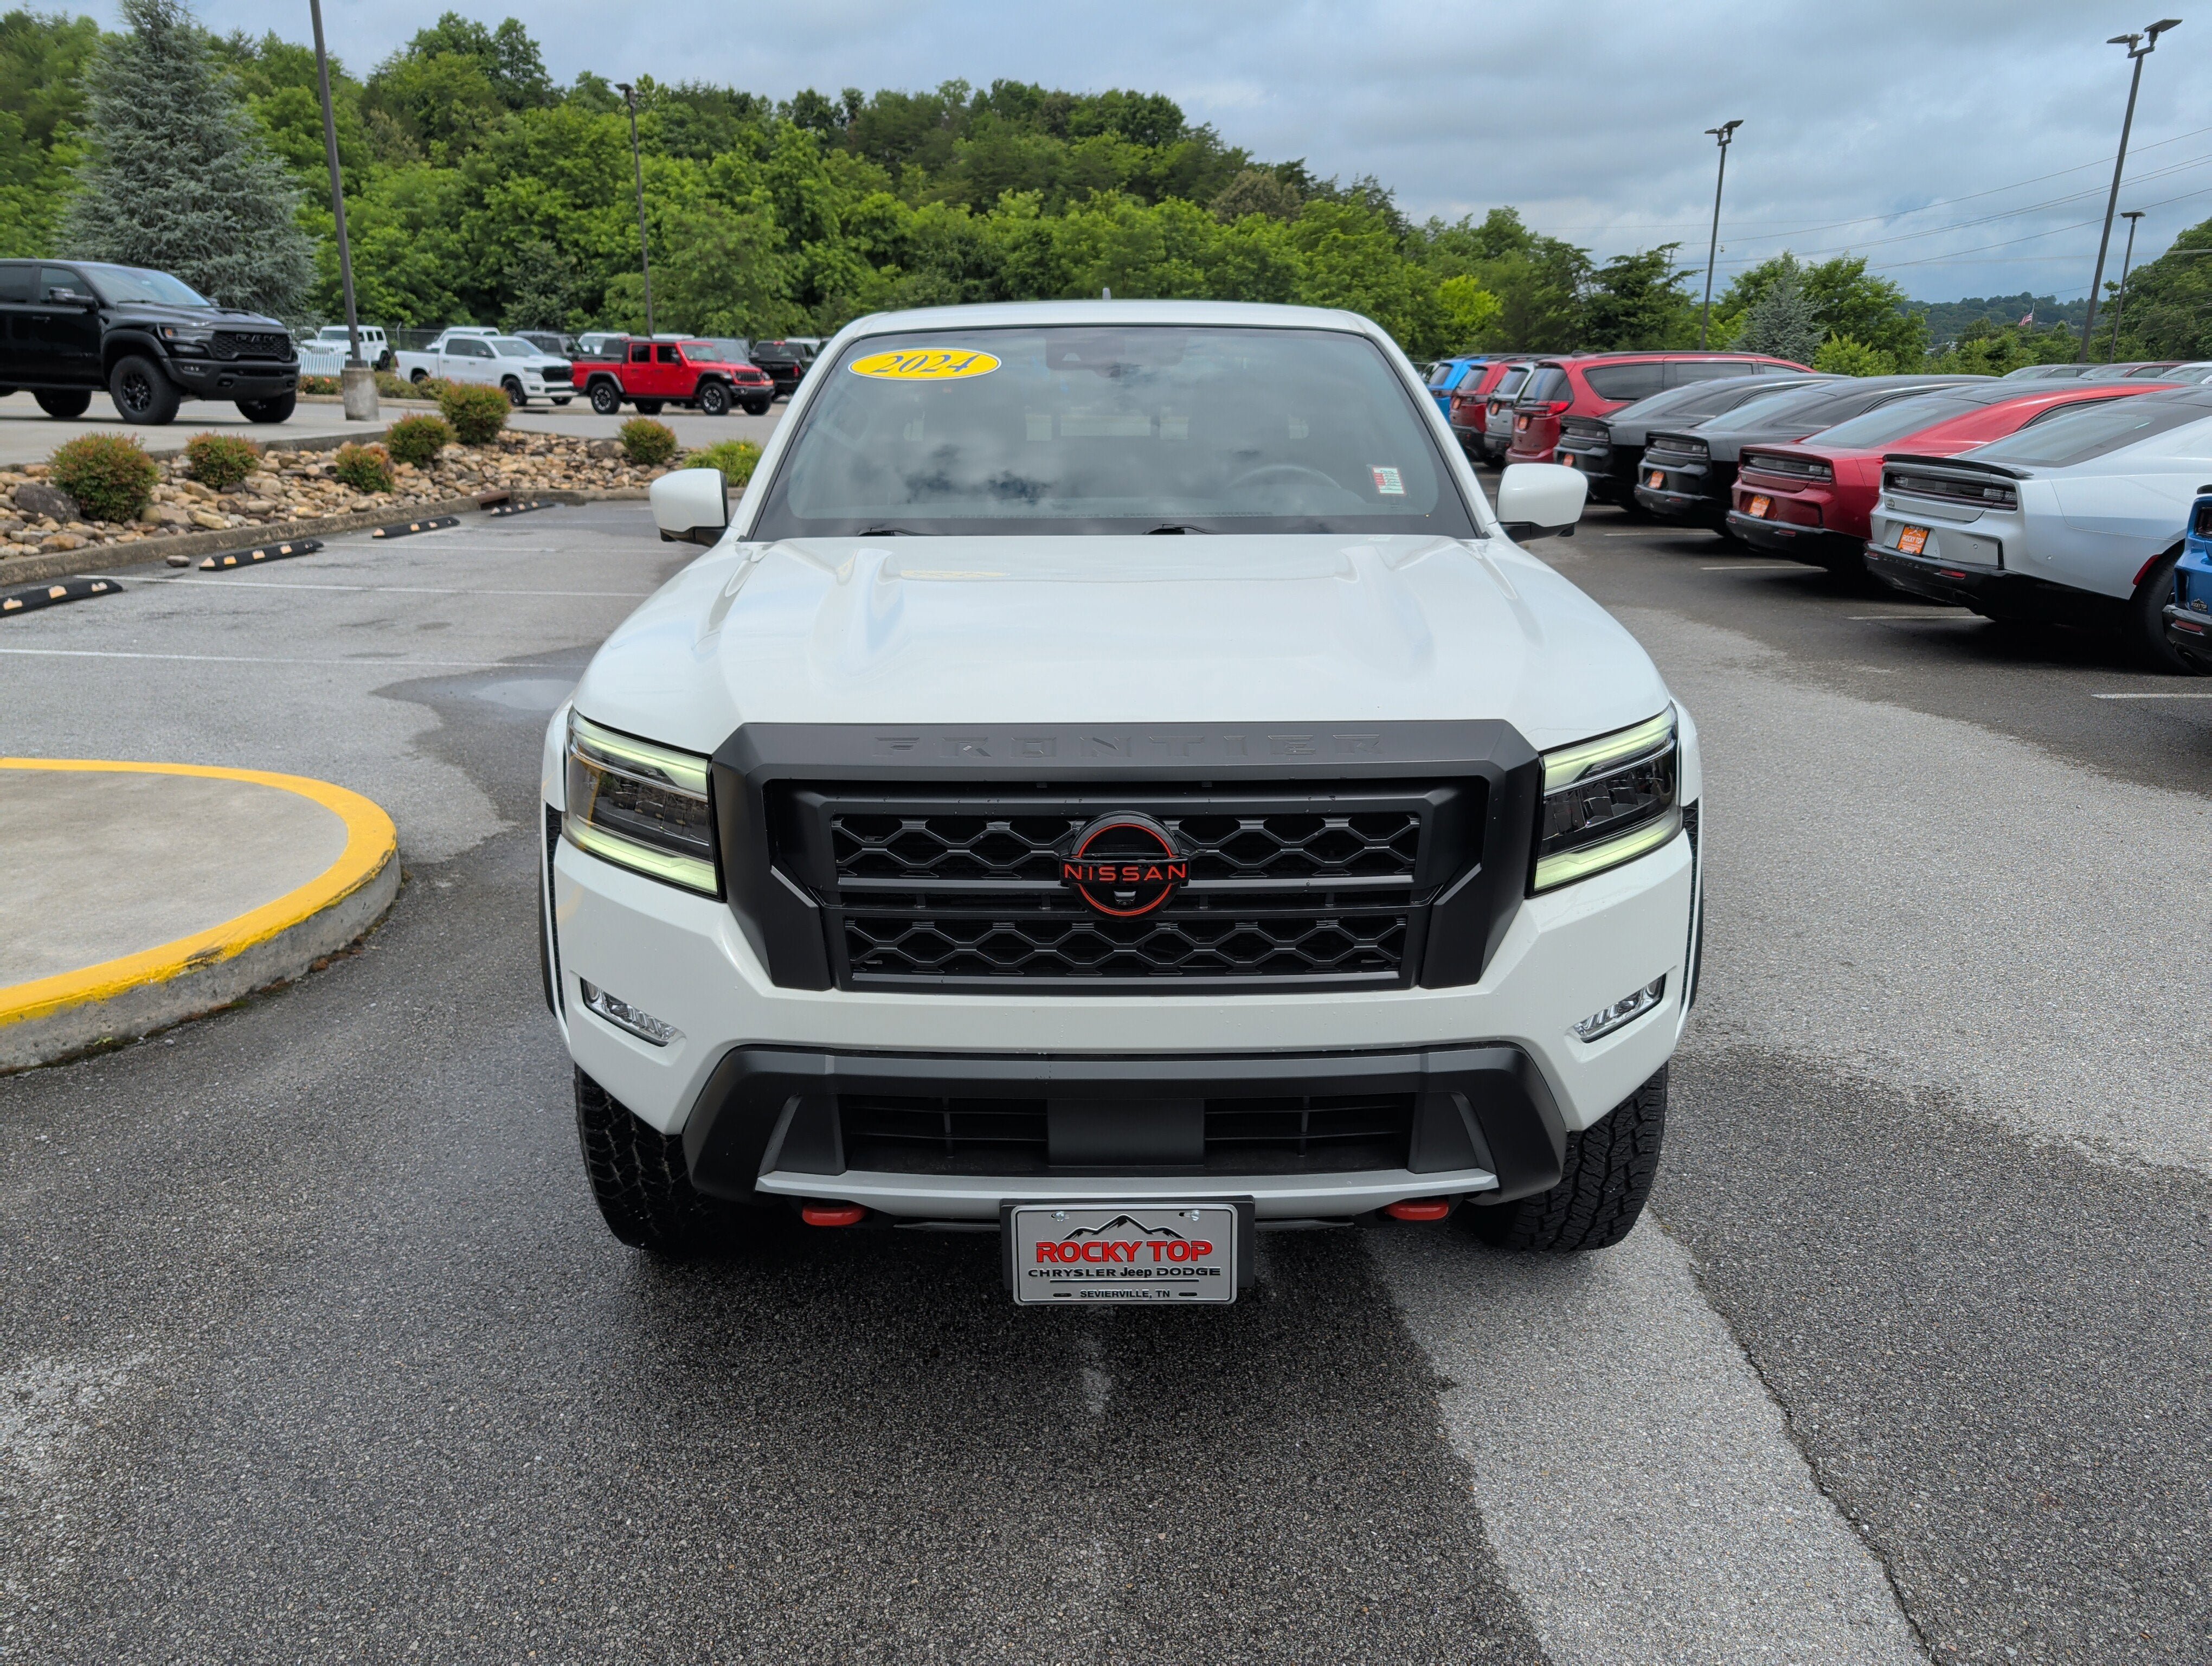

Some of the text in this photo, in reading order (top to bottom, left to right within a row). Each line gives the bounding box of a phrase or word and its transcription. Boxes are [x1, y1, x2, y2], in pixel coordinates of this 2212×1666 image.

[870, 354, 980, 373] 2024
[872, 734, 1387, 758] FRONTIER
[1064, 863, 1186, 881] NISSAN
[1036, 1240, 1213, 1263] ROCKY TOP
[1028, 1266, 1221, 1278] CHRYSLER Jeep DODGE
[1080, 1289, 1171, 1299] SEVIERVILLE, TN
